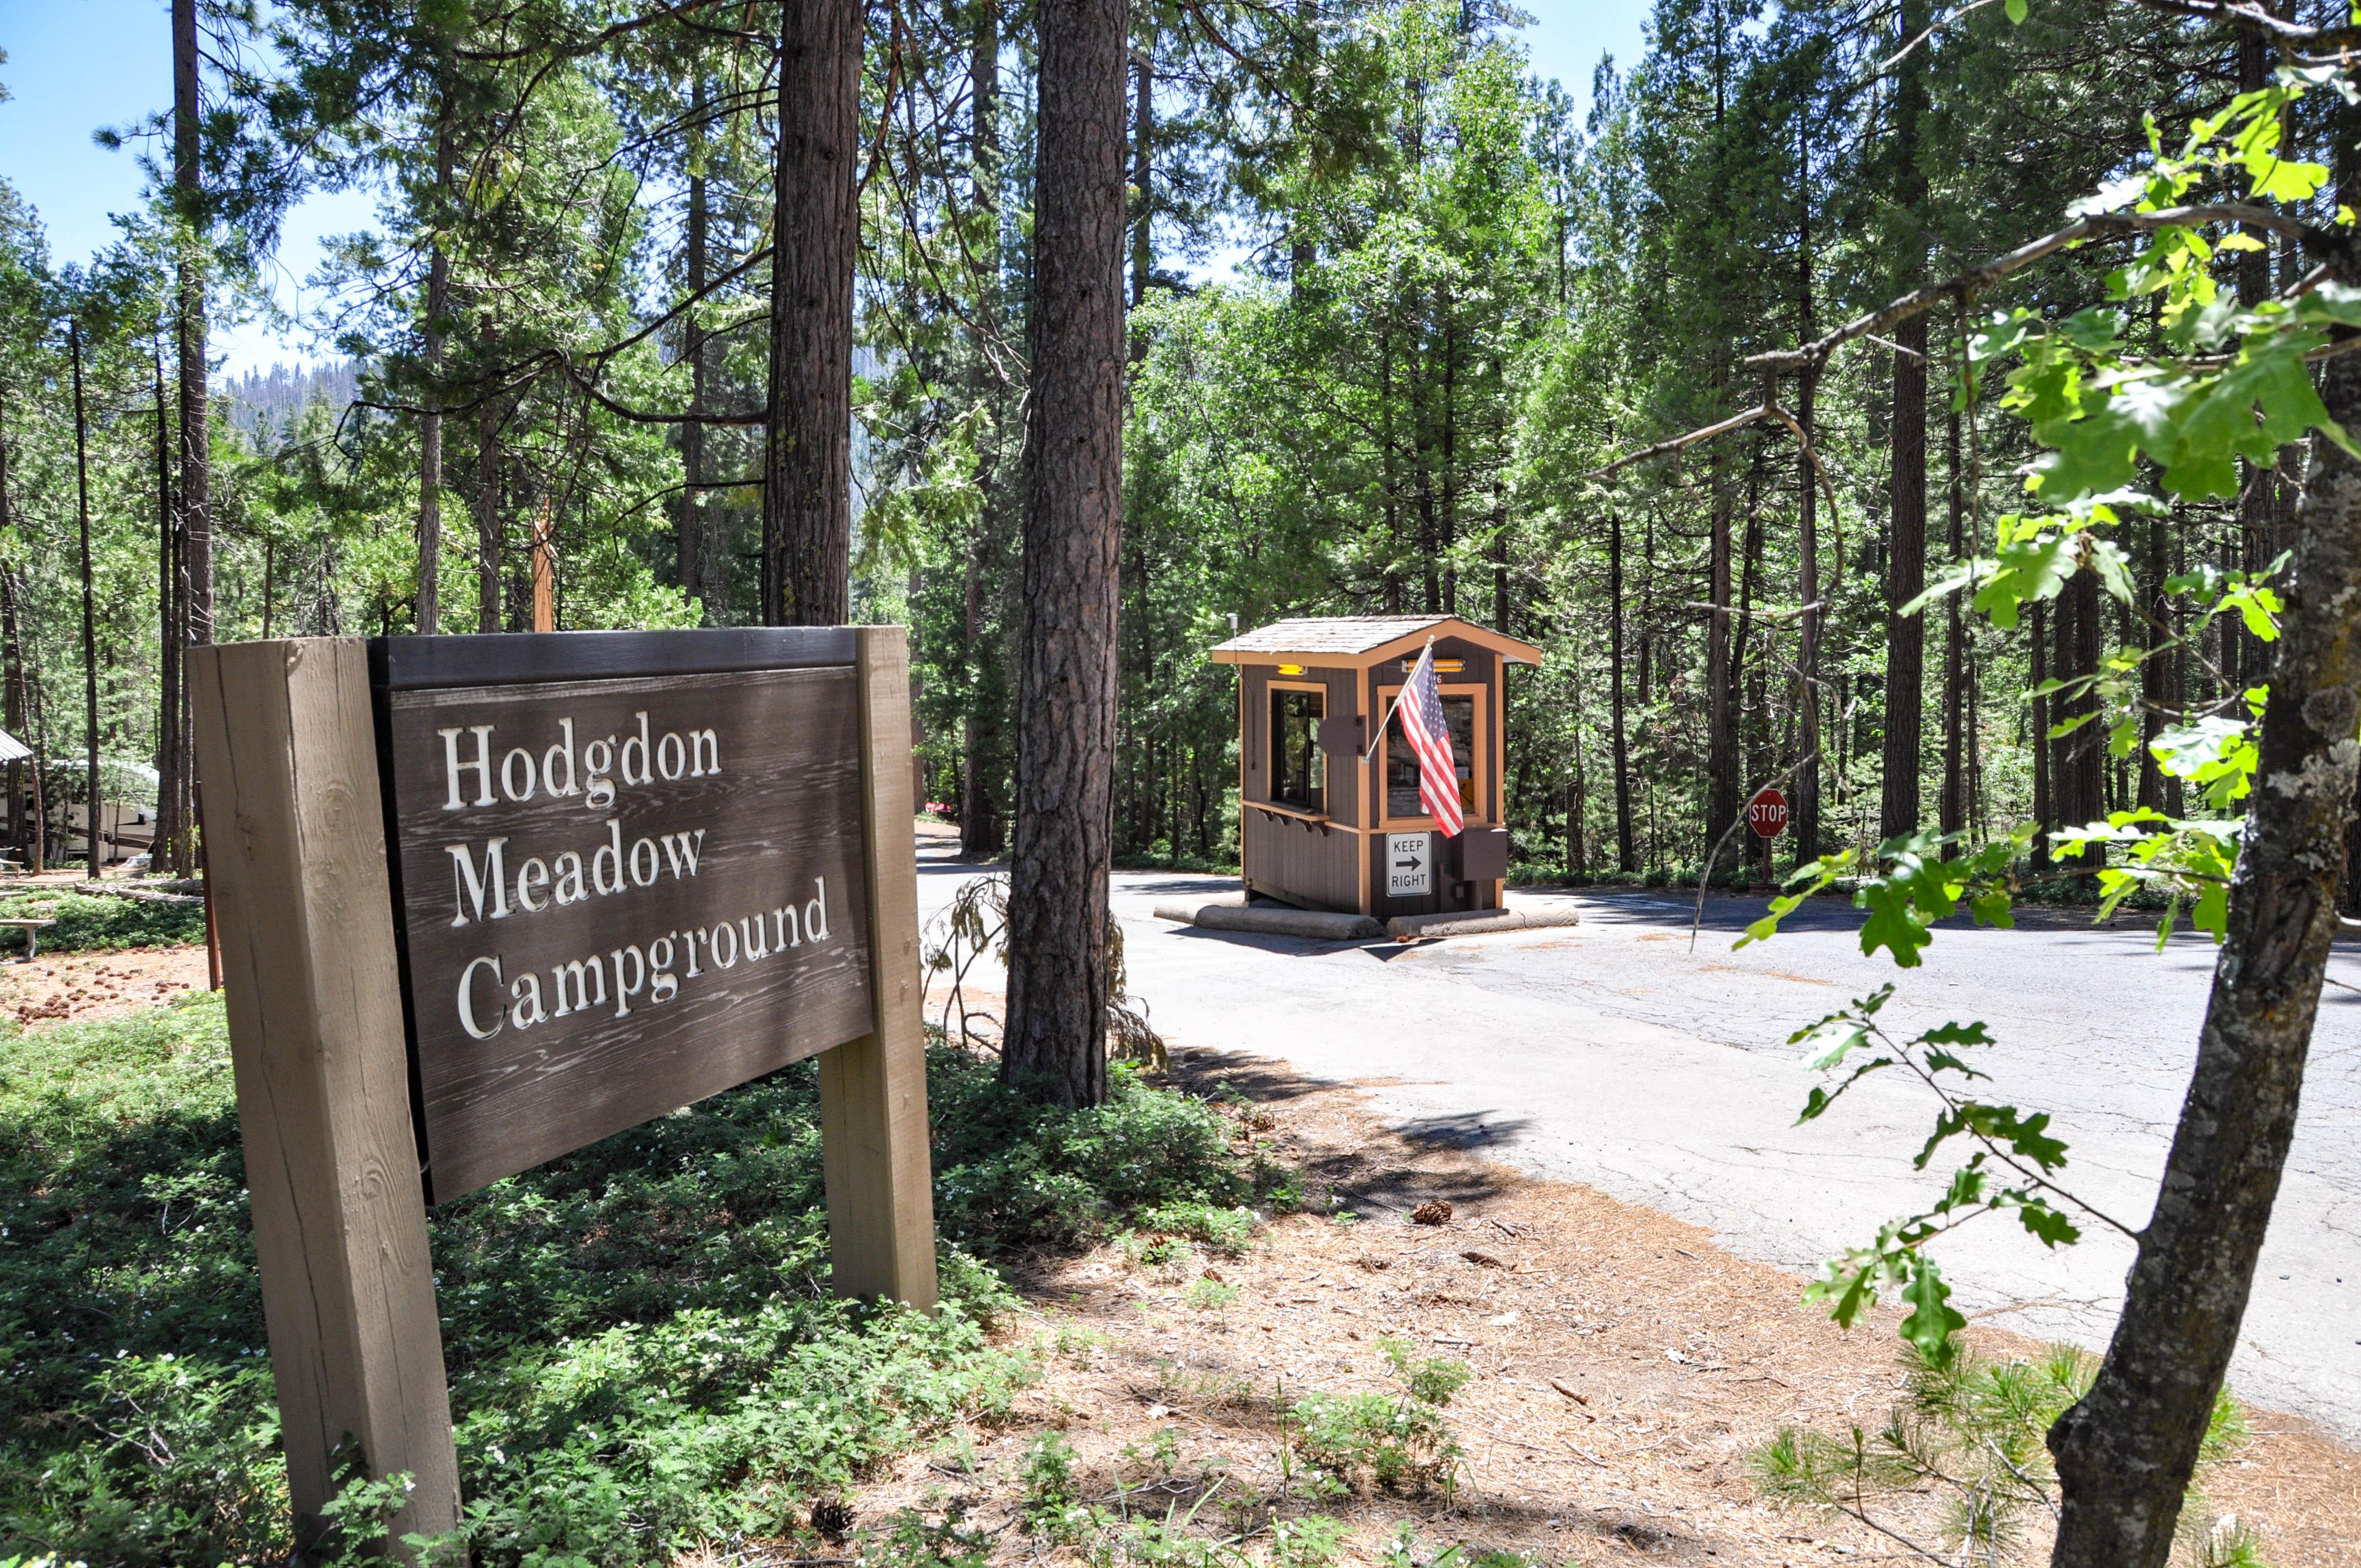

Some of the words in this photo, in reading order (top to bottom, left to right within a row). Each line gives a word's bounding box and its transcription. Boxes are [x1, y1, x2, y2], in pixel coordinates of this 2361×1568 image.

[438, 711, 722, 810] Hodgdon
[1751, 804, 1787, 822] STOP
[445, 818, 706, 928] Meadow
[1394, 840, 1423, 852] KEEP
[1392, 874, 1426, 887] RIGHT
[458, 875, 833, 1040] Campground
